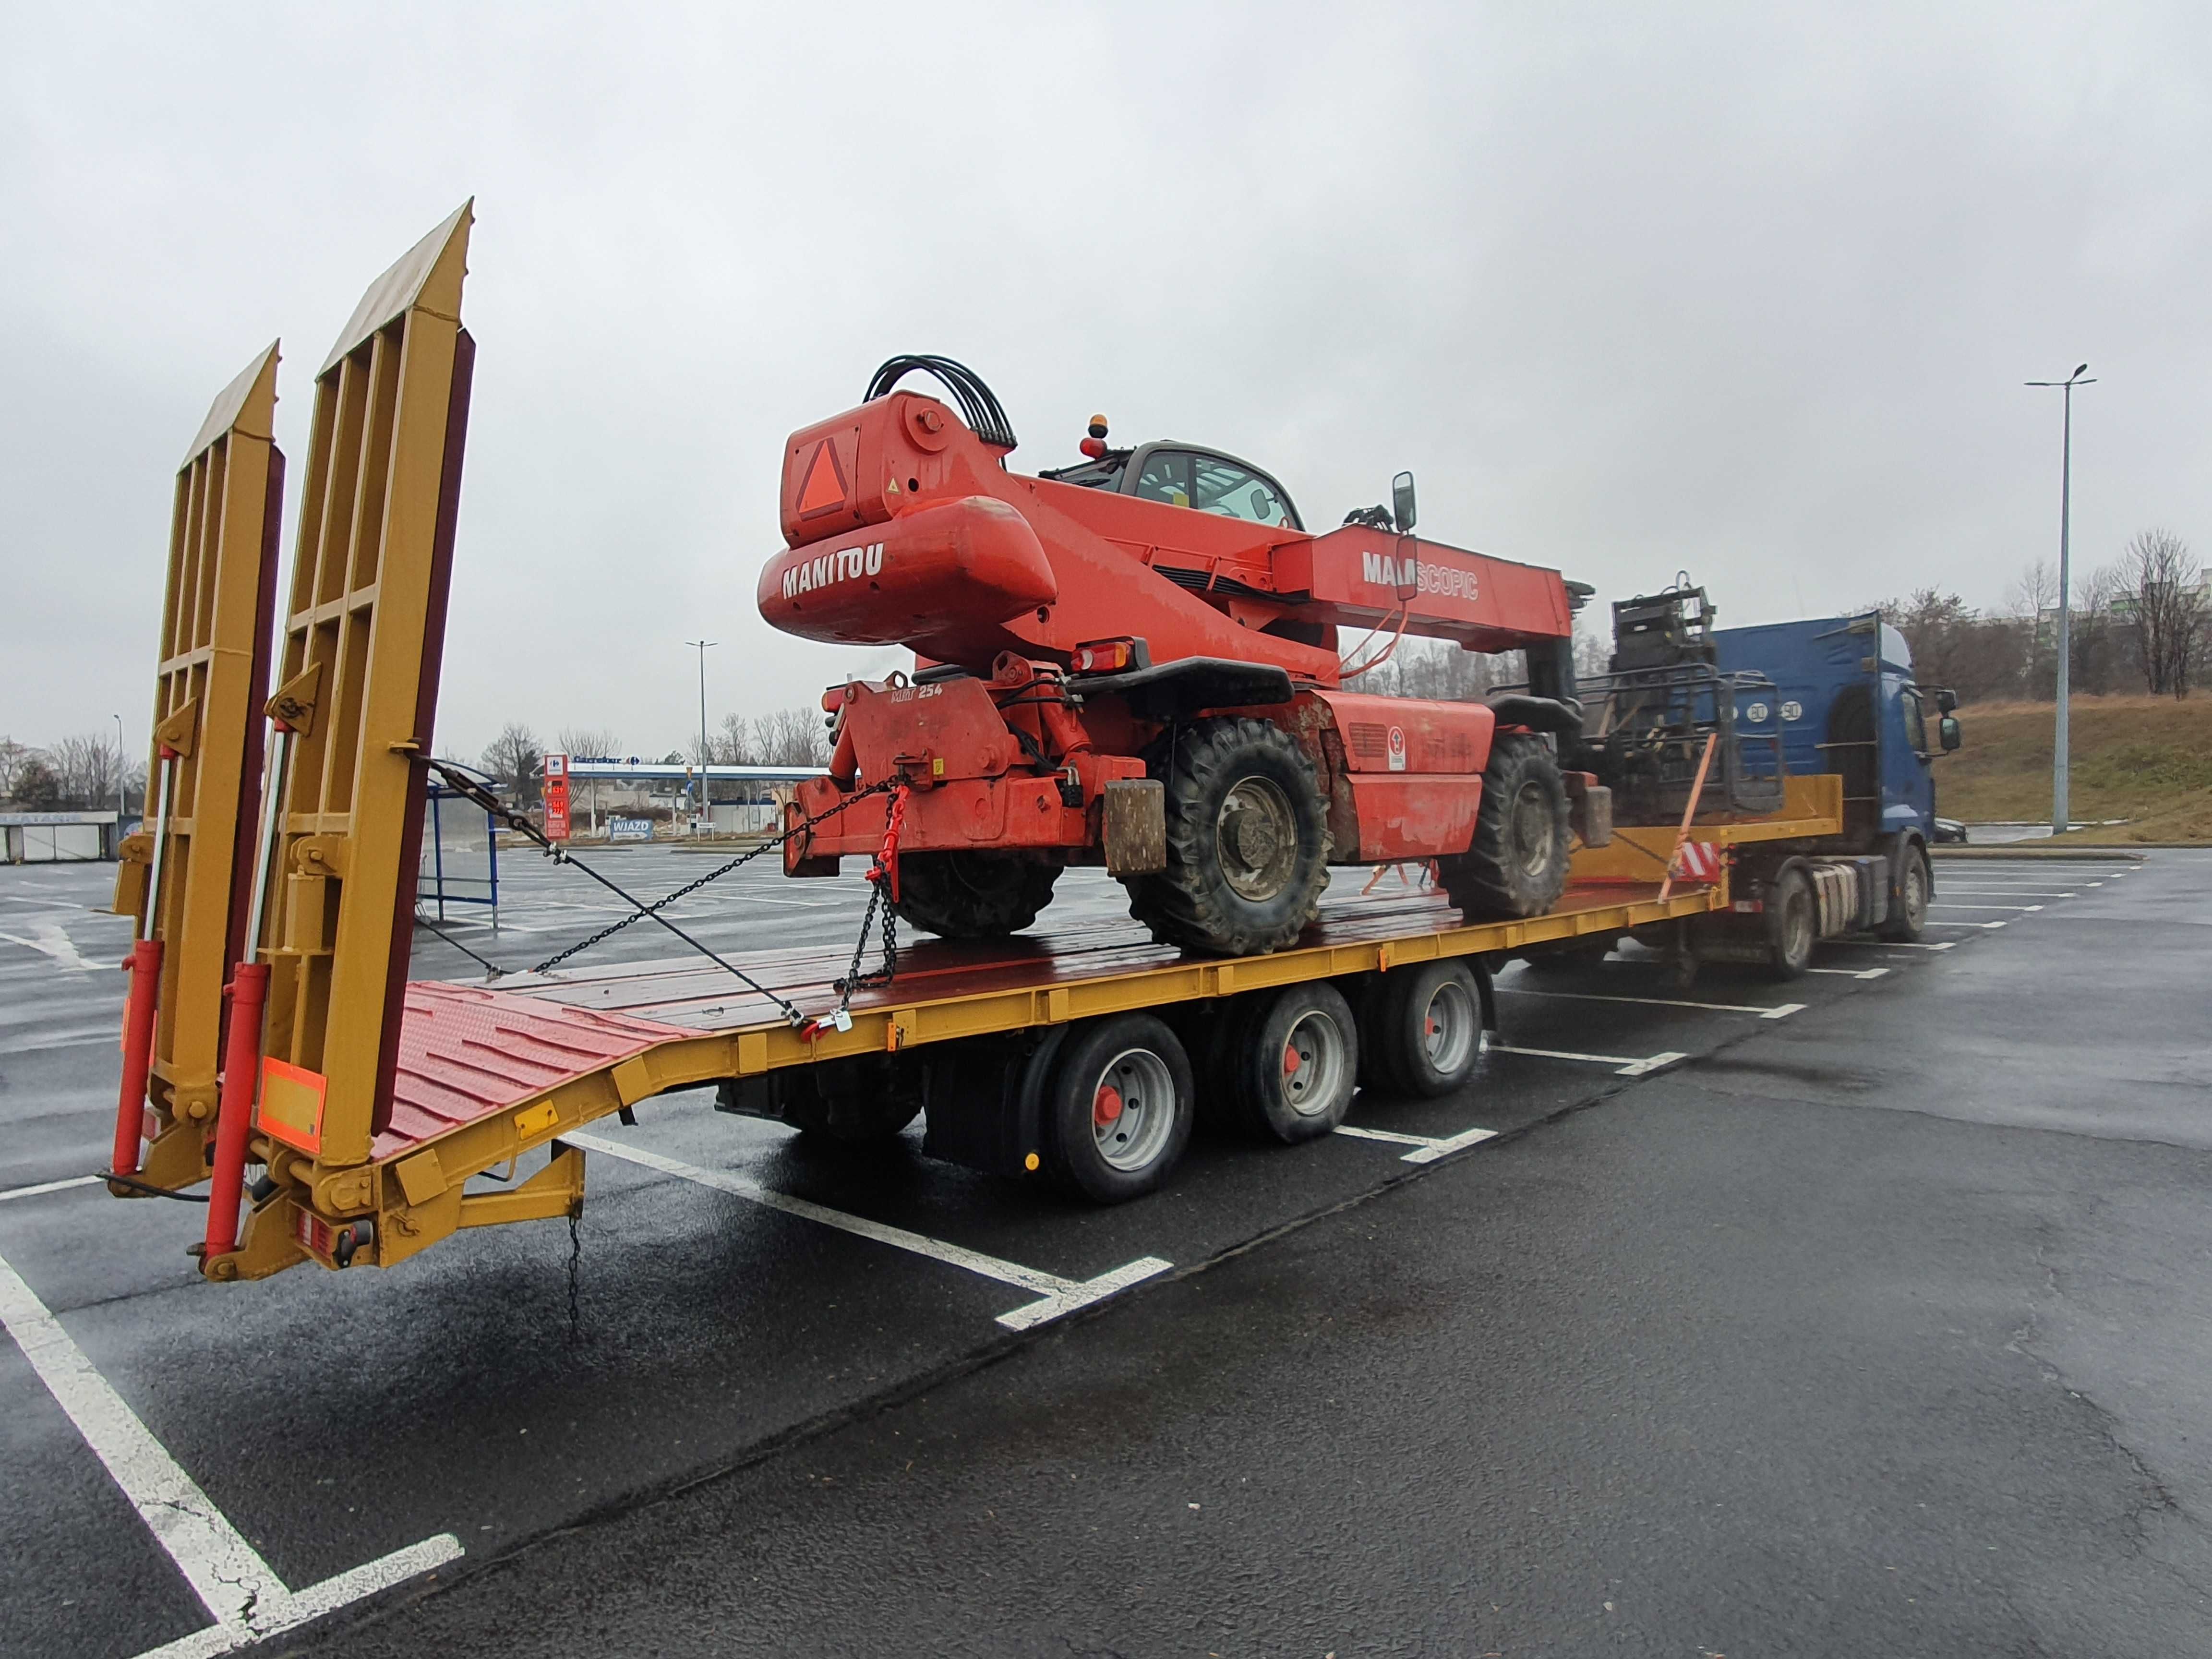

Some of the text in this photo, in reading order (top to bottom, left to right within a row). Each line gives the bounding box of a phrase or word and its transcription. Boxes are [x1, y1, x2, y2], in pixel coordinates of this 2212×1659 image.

[783, 543, 884, 600] MANITOU
[918, 684, 943, 699] 254
[574, 755, 622, 763] Carrefour
[613, 821, 649, 831] WJAZD
